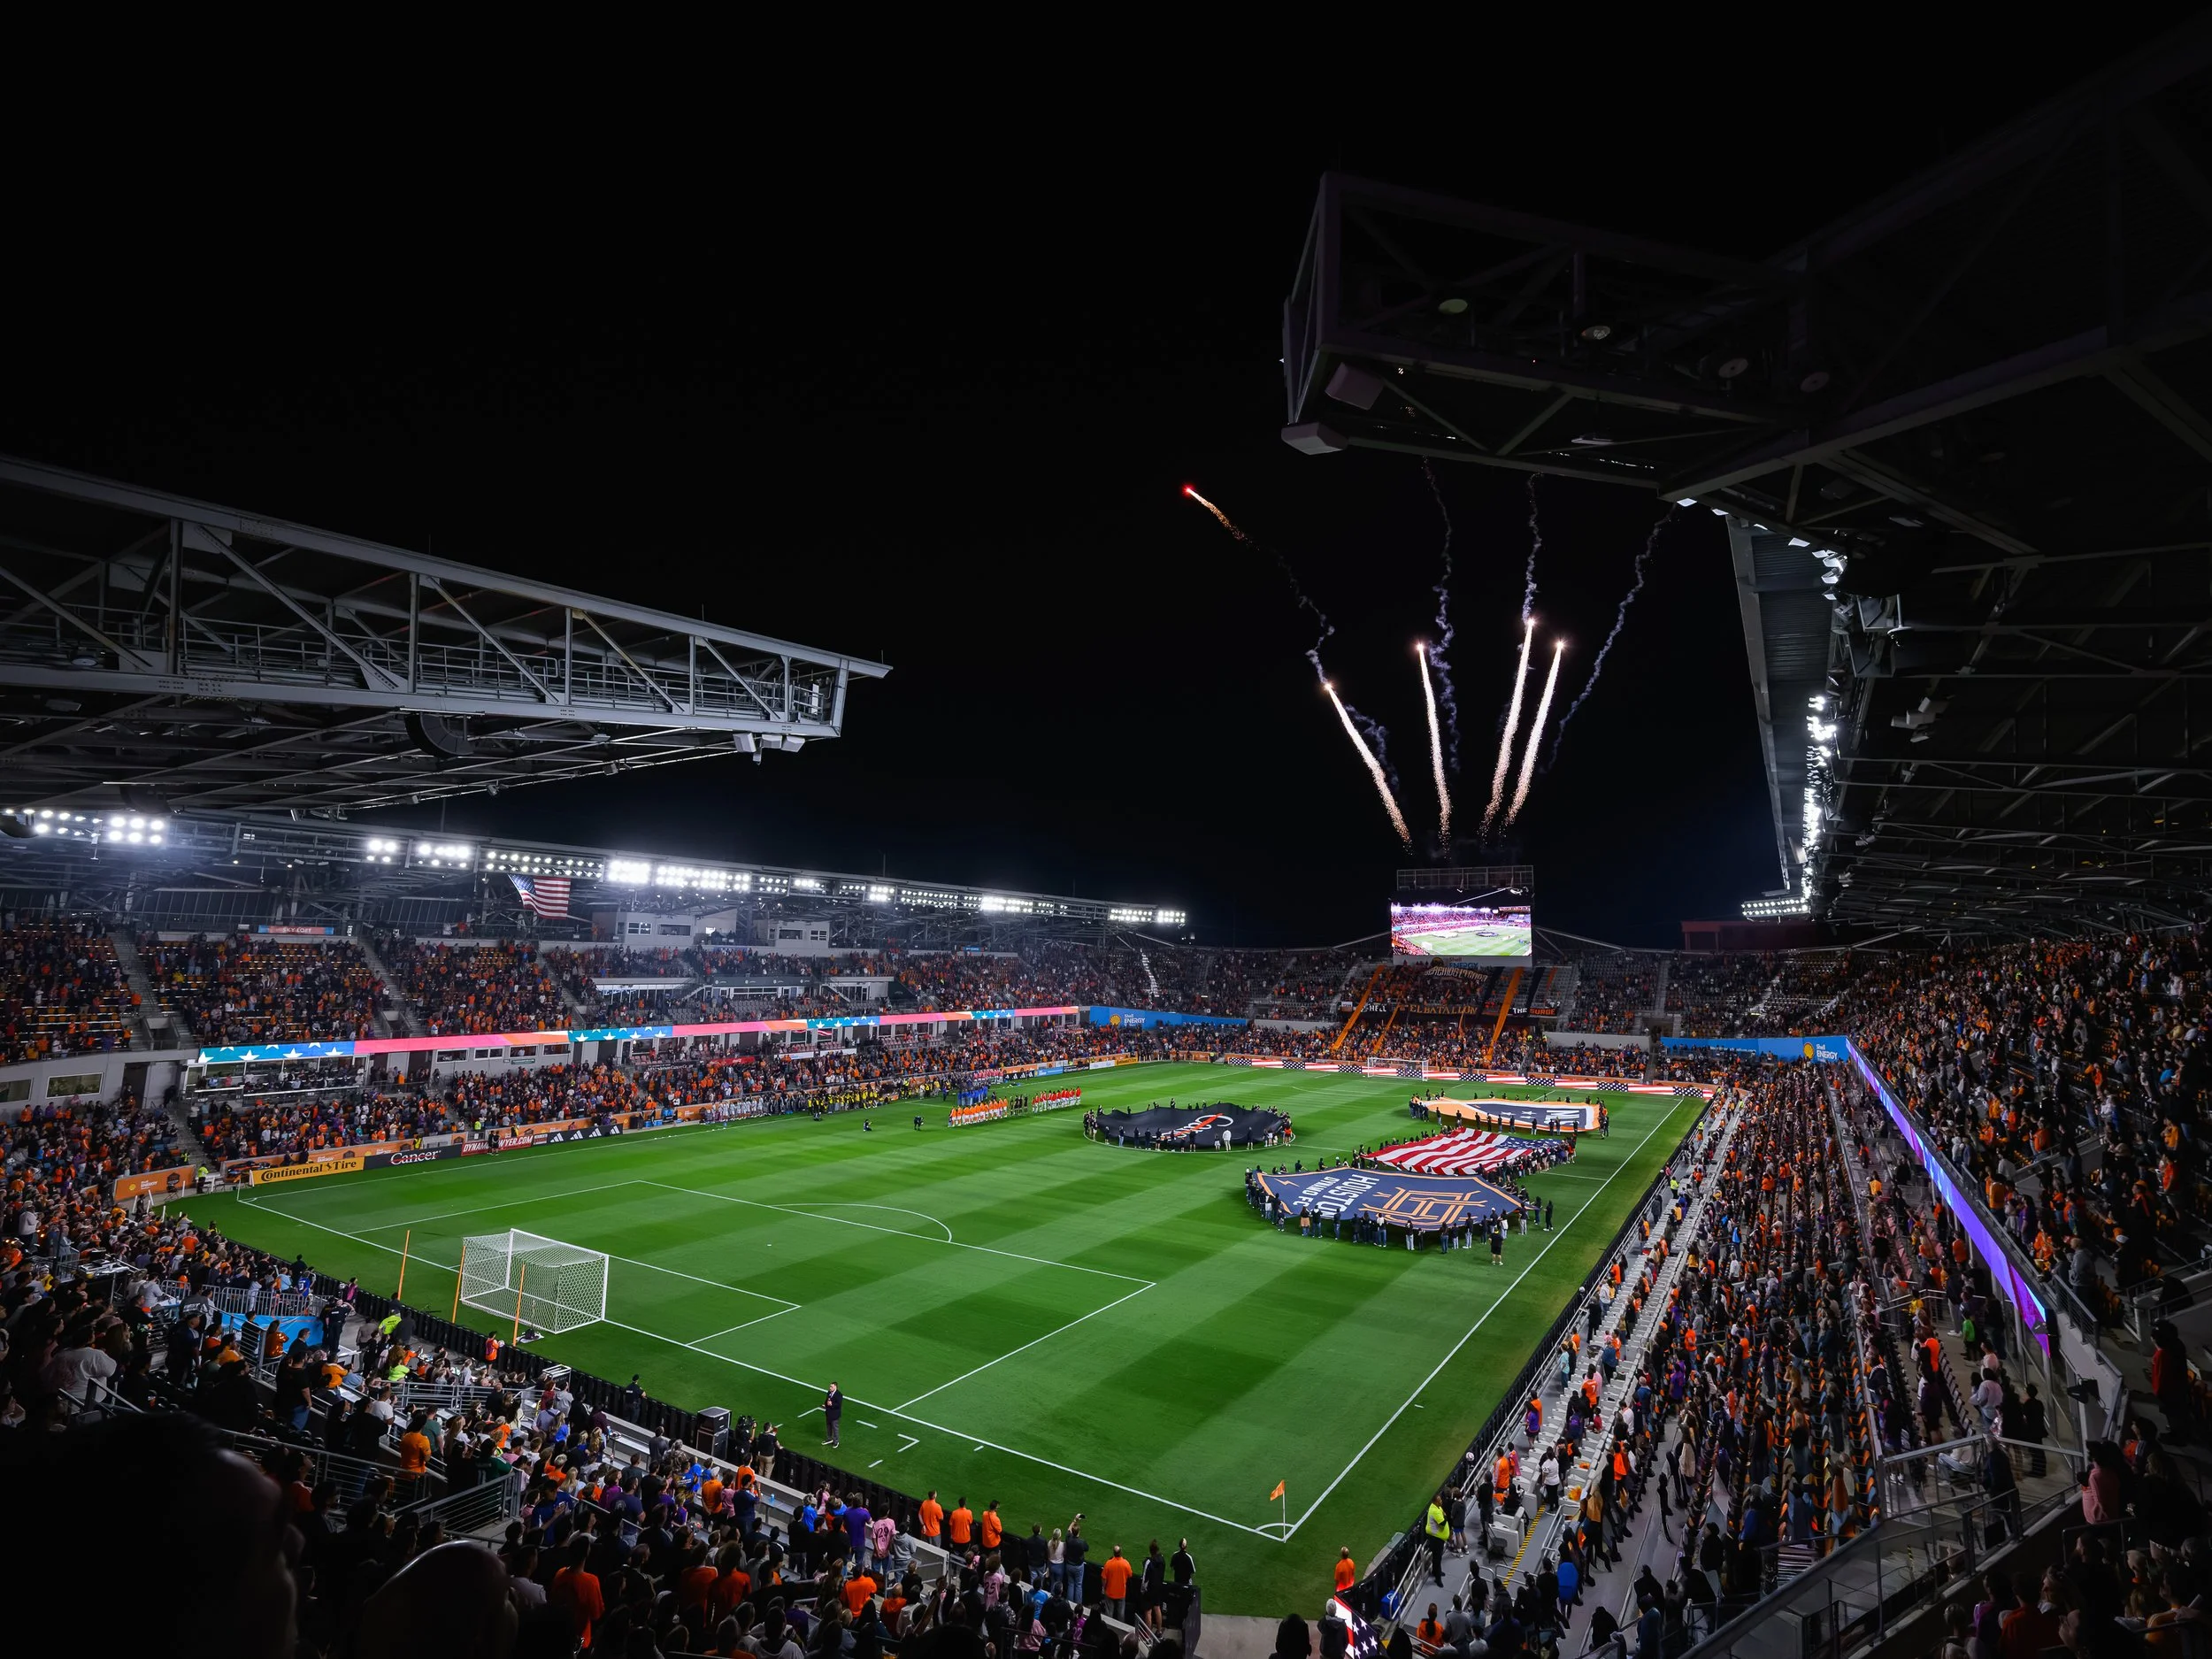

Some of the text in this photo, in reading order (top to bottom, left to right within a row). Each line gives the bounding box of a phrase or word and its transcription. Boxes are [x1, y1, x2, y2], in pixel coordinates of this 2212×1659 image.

[1816, 1049, 1839, 1061] ENERGY
[390, 1150, 440, 1165] Cancer
[261, 1160, 357, 1182] Continental Tire
[1293, 1176, 1340, 1207] DYNAMO FC
[1316, 1174, 1380, 1219] HOUSTON
[878, 1526, 889, 1538] 29
